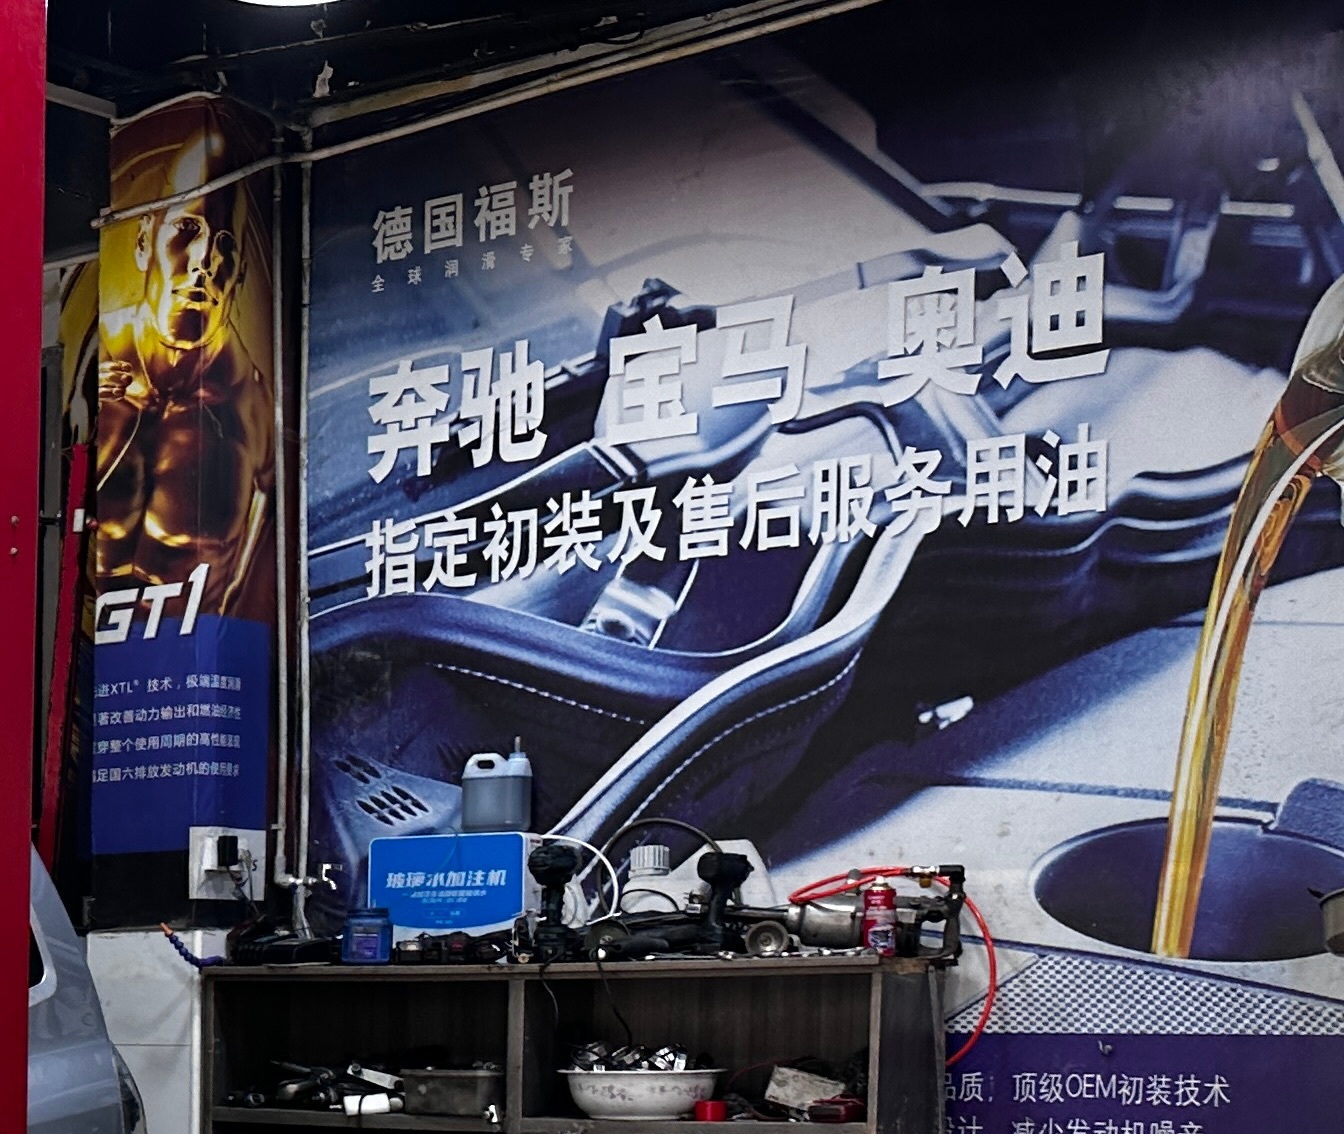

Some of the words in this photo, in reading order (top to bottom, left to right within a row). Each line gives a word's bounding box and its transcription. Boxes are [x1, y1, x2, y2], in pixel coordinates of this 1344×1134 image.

[372, 168, 573, 264] 德国福斯
[371, 236, 572, 293] 全球润滑专家
[368, 339, 548, 483] 奔驰
[610, 295, 807, 447] 宝马
[878, 240, 1111, 407] 奥迪
[365, 422, 1109, 598] 指定初装及售后服务用油
[94, 562, 210, 645] GT1
